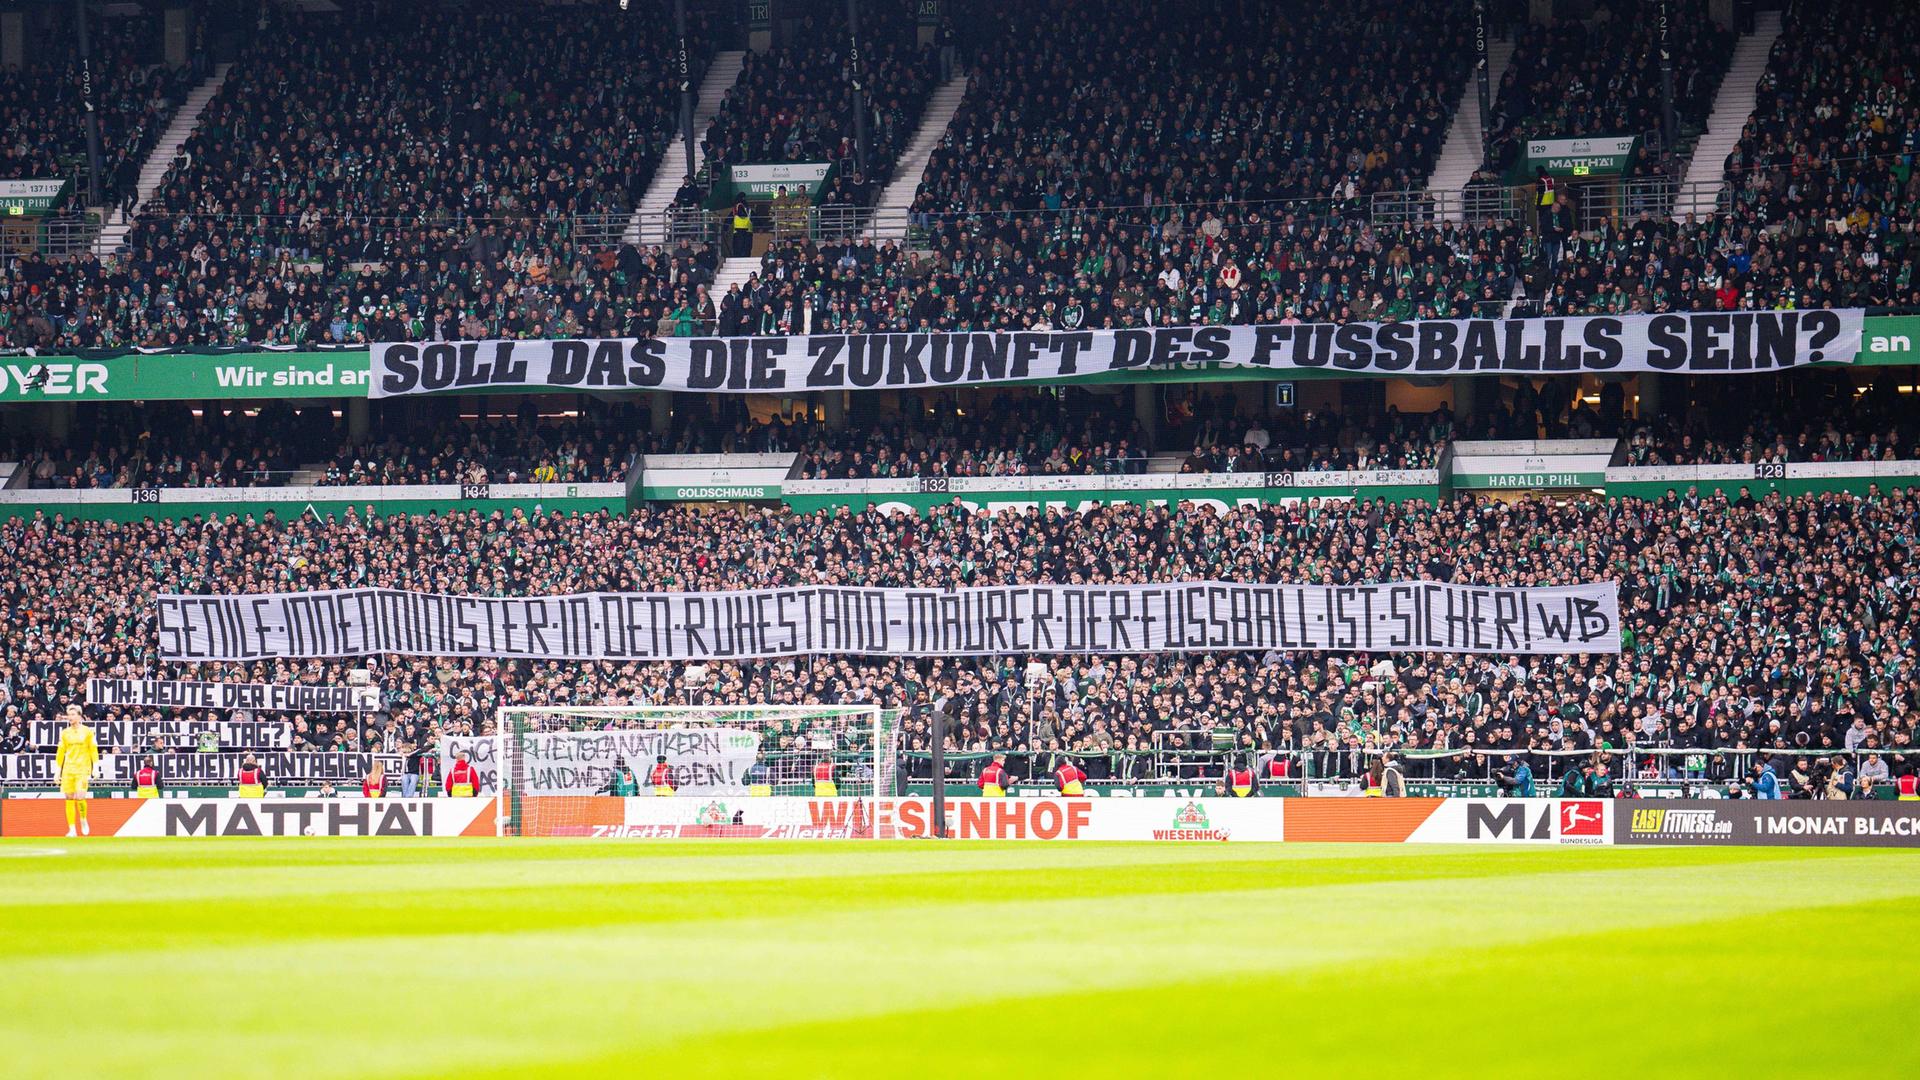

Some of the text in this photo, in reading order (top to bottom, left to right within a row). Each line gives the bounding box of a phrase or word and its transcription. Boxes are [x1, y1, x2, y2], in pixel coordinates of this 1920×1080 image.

[1476, 14, 1484, 51] 129
[1659, 4, 1667, 41] 127
[679, 38, 688, 73] 133
[850, 37, 858, 72] 131
[83, 59, 91, 94] 135
[1531, 142, 1631, 154] 129 127
[734, 170, 749, 178] 133
[382, 310, 1841, 394] SOLL DAS DIE ZUKUNFT DES FUSSBALLS SEIN?
[1870, 335, 1911, 353] an
[215, 366, 267, 387] Wir
[273, 363, 333, 386] sind
[1266, 473, 1293, 487] 130
[1489, 474, 1580, 486] HARALD PIHL
[1757, 464, 1784, 478] 128
[133, 489, 159, 502] 136
[677, 487, 764, 498] GOLDSCHMAUS
[920, 479, 946, 492] 132
[92, 679, 138, 703] IMK:
[142, 681, 215, 707] HEUTE
[222, 683, 265, 708] DER
[35, 721, 125, 746] MOEN
[165, 803, 433, 837] MATTHÄI
[1754, 816, 1762, 834] 1
[1768, 816, 1848, 835] MONAT
